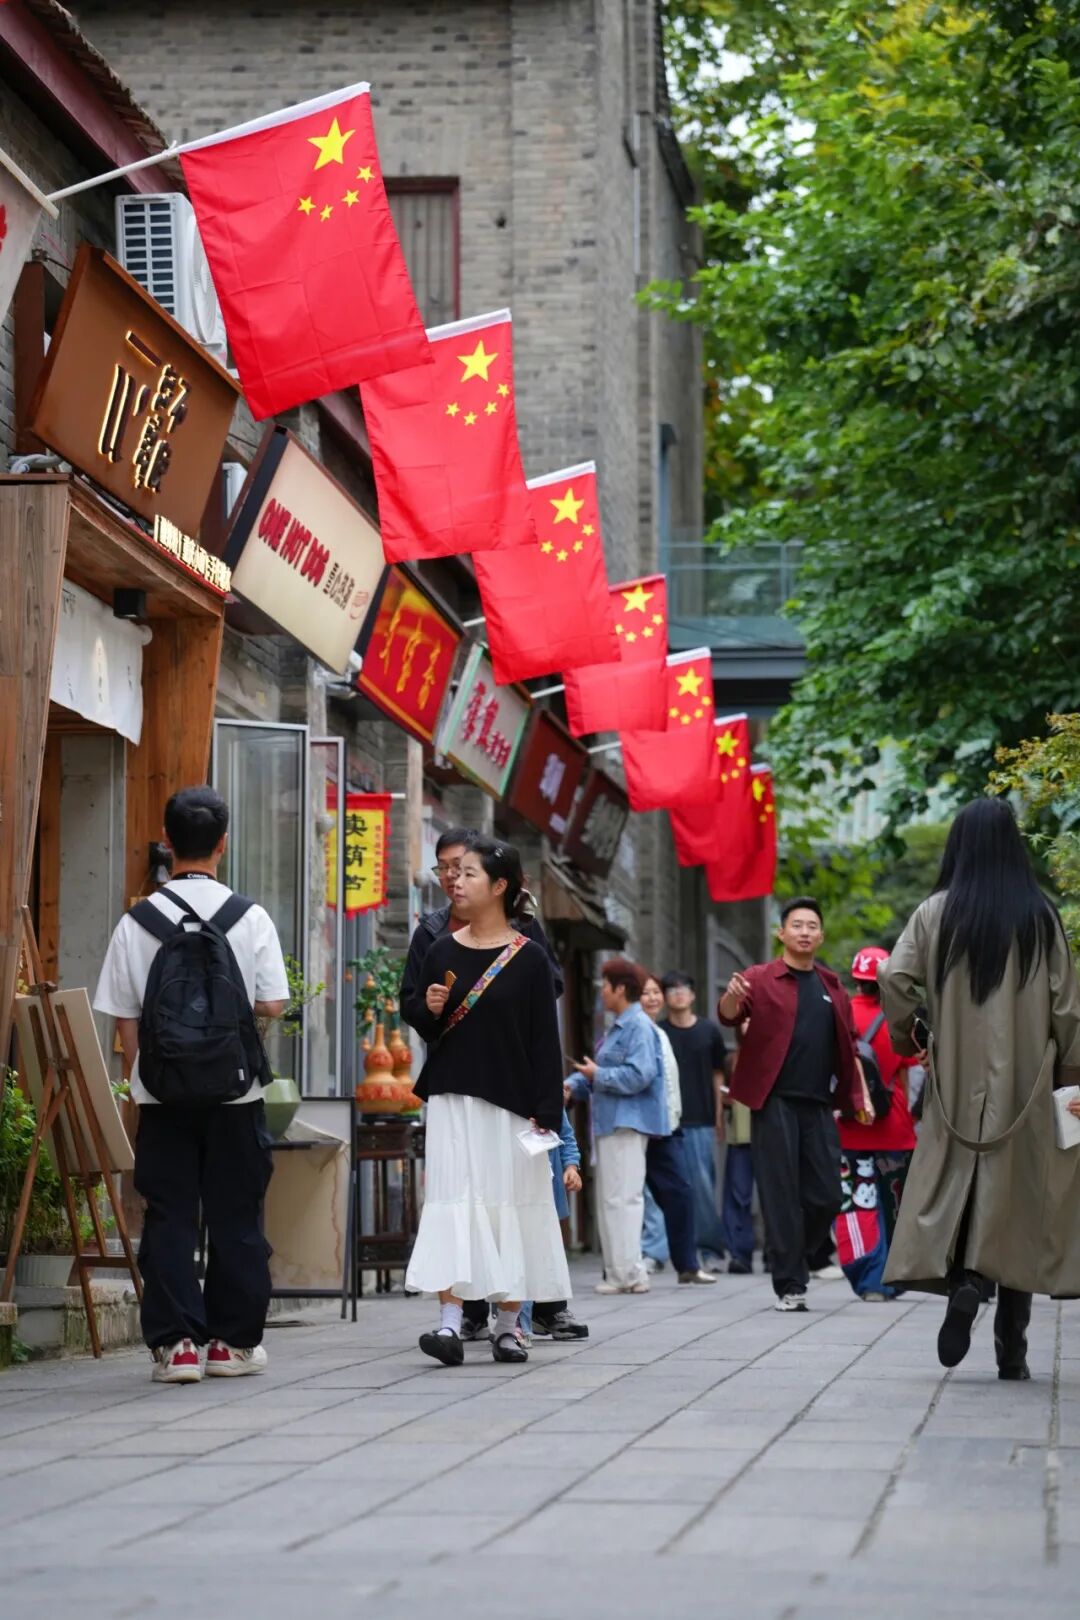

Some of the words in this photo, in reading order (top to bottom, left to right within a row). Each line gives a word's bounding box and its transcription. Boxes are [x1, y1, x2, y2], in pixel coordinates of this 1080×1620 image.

[258, 498, 292, 551] ONE
[279, 518, 312, 569] HOT
[300, 538, 330, 587] DOG
